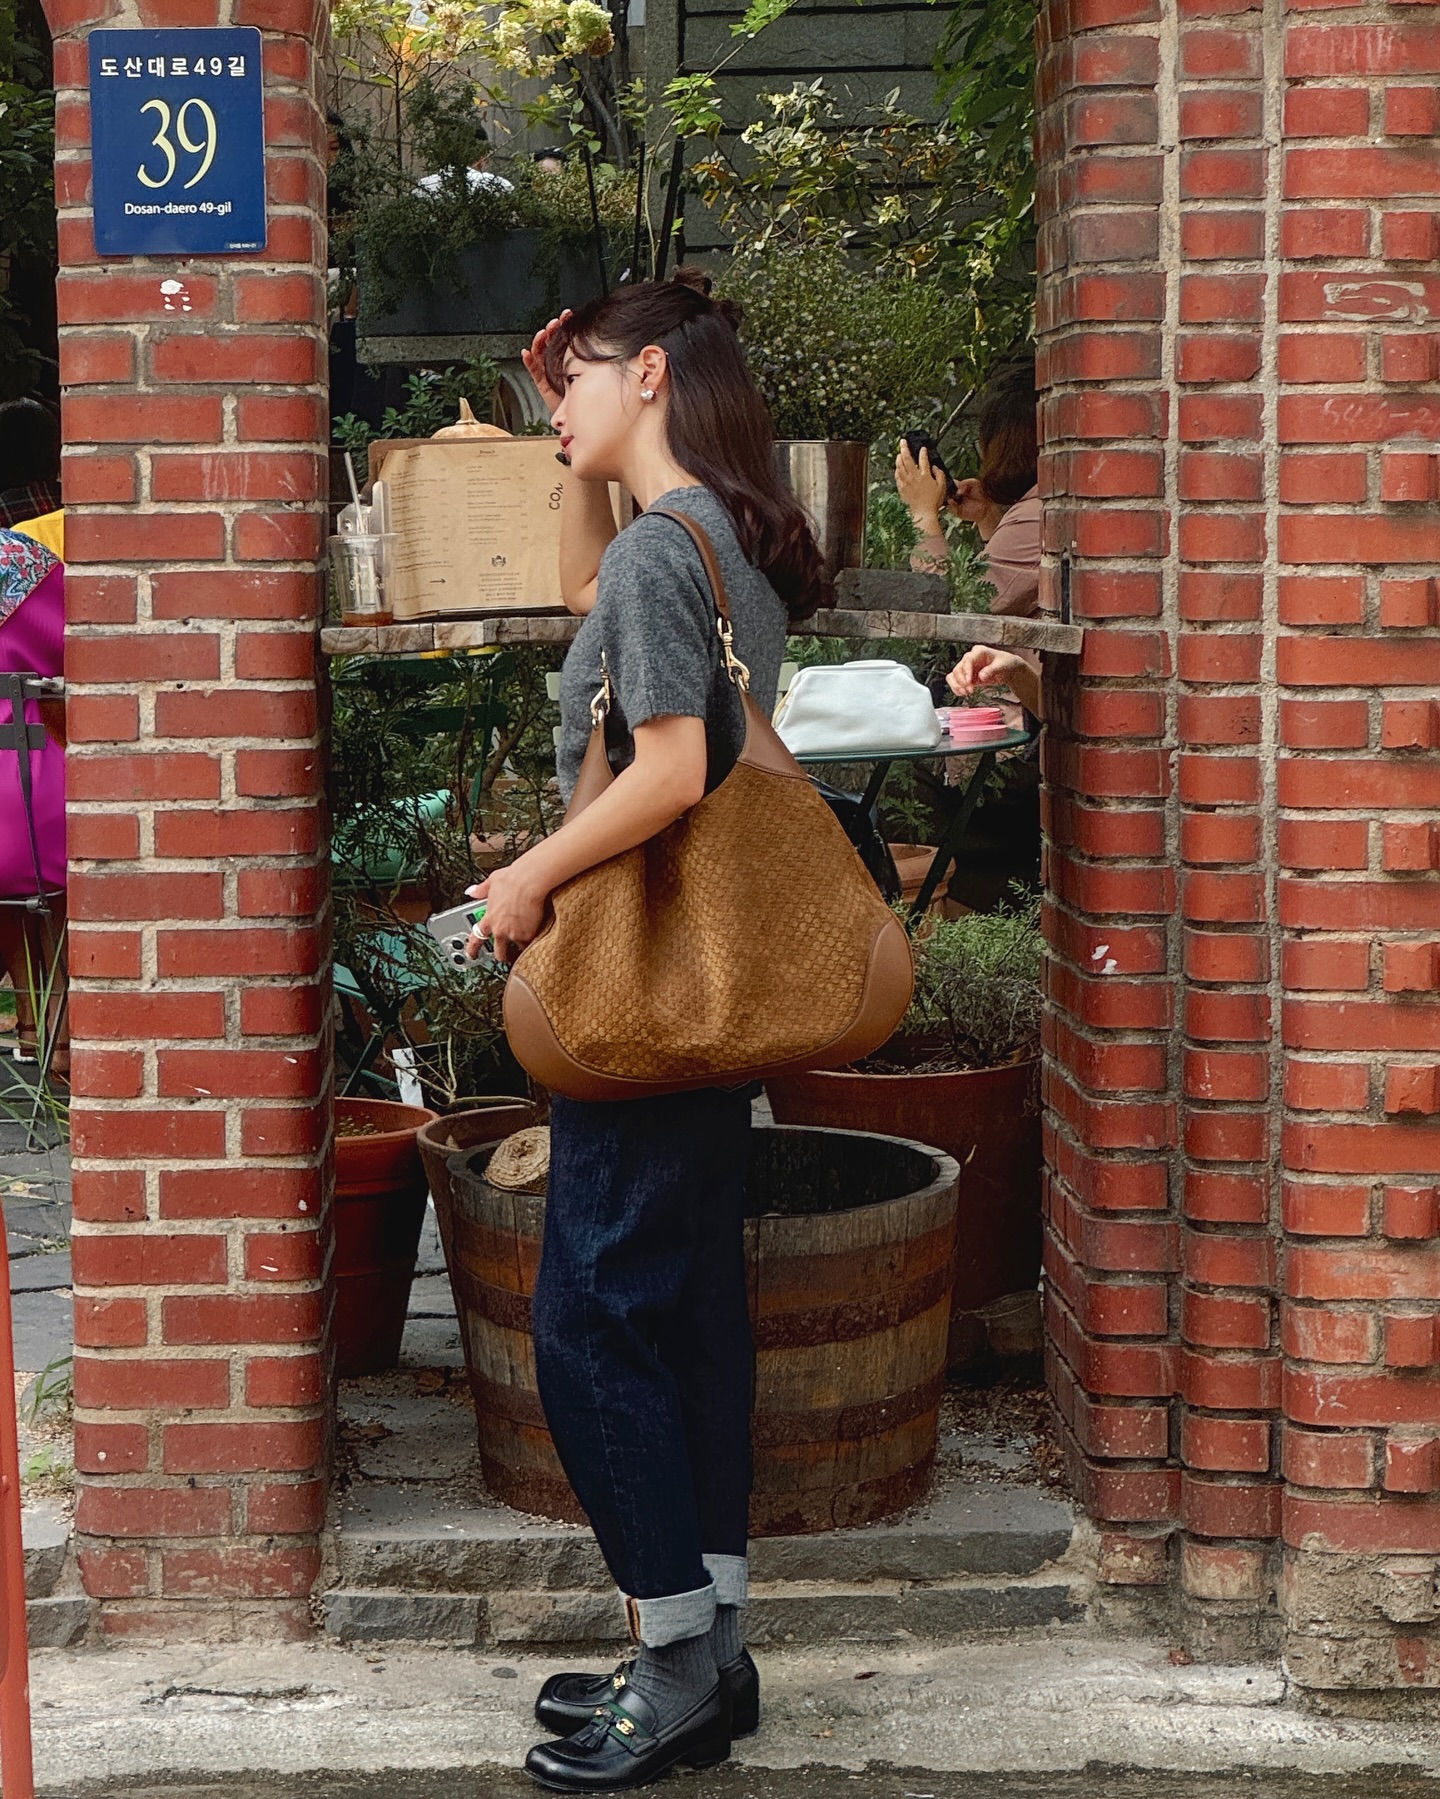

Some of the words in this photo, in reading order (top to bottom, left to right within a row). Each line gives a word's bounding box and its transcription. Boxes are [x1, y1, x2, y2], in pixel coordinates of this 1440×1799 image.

[100, 56, 246, 78] 도산대로49길
[137, 98, 217, 189] 39
[124, 202, 197, 215] Dosan-daero
[199, 201, 232, 216] 49-gil
